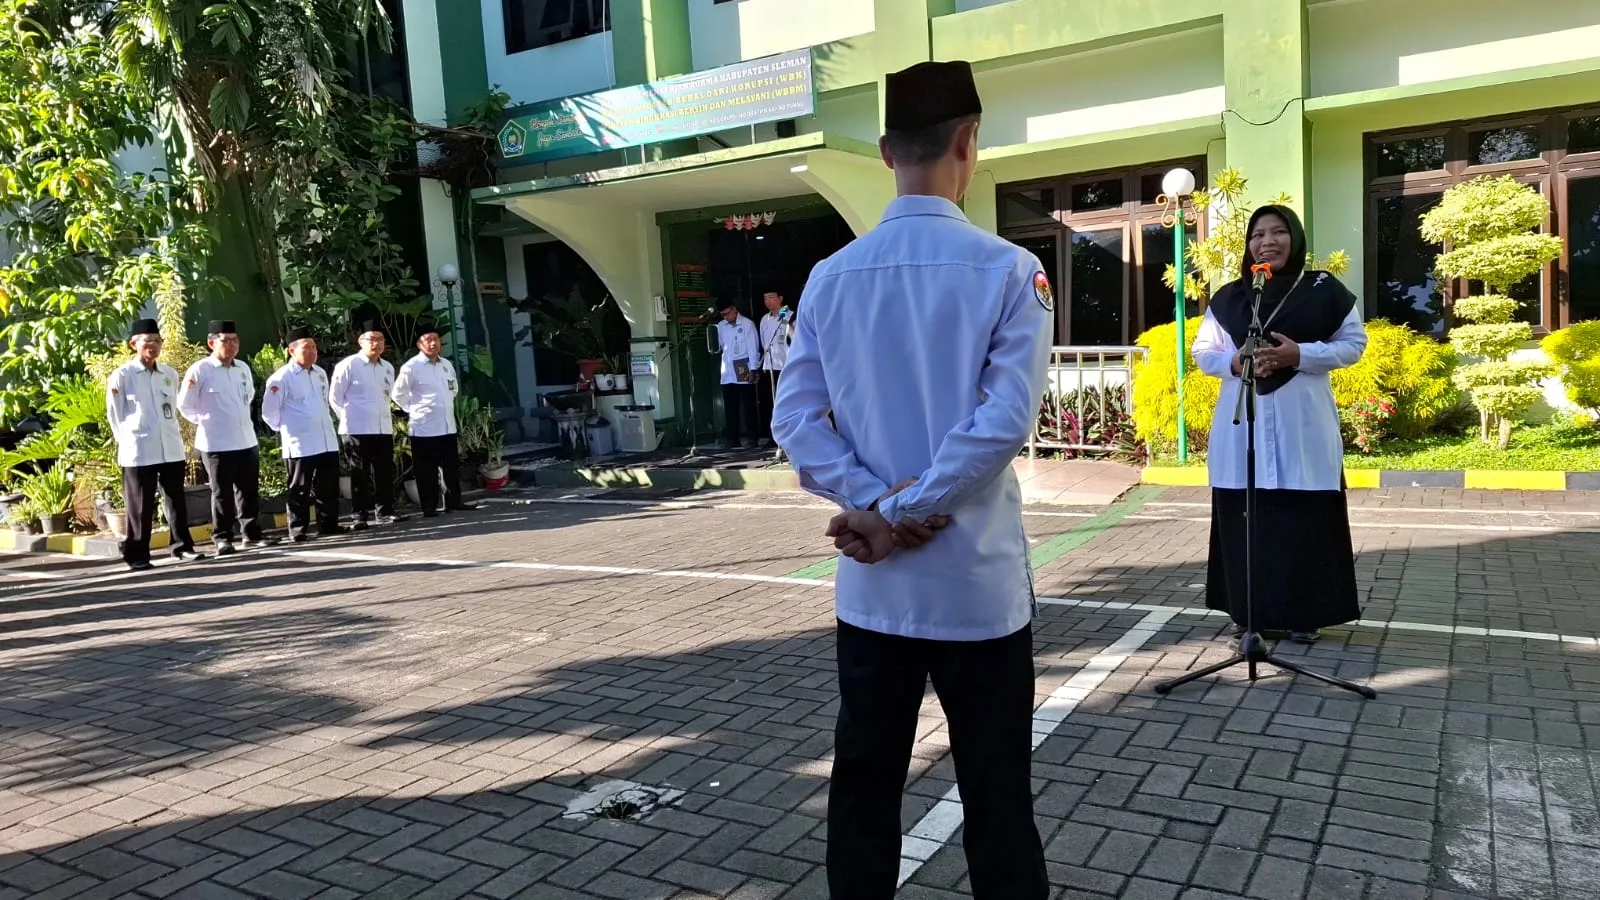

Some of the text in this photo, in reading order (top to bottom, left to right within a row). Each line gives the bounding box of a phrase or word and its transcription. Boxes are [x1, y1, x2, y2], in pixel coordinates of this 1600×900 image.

[771, 57, 807, 72] SLEMAN
[706, 86, 729, 98] DARI
[731, 77, 773, 93] KORUPSI
[776, 71, 807, 85] (WBK)
[710, 100, 727, 110] DAN
[728, 91, 770, 105] MELAYANI
[772, 84, 807, 99] (WBBM)
